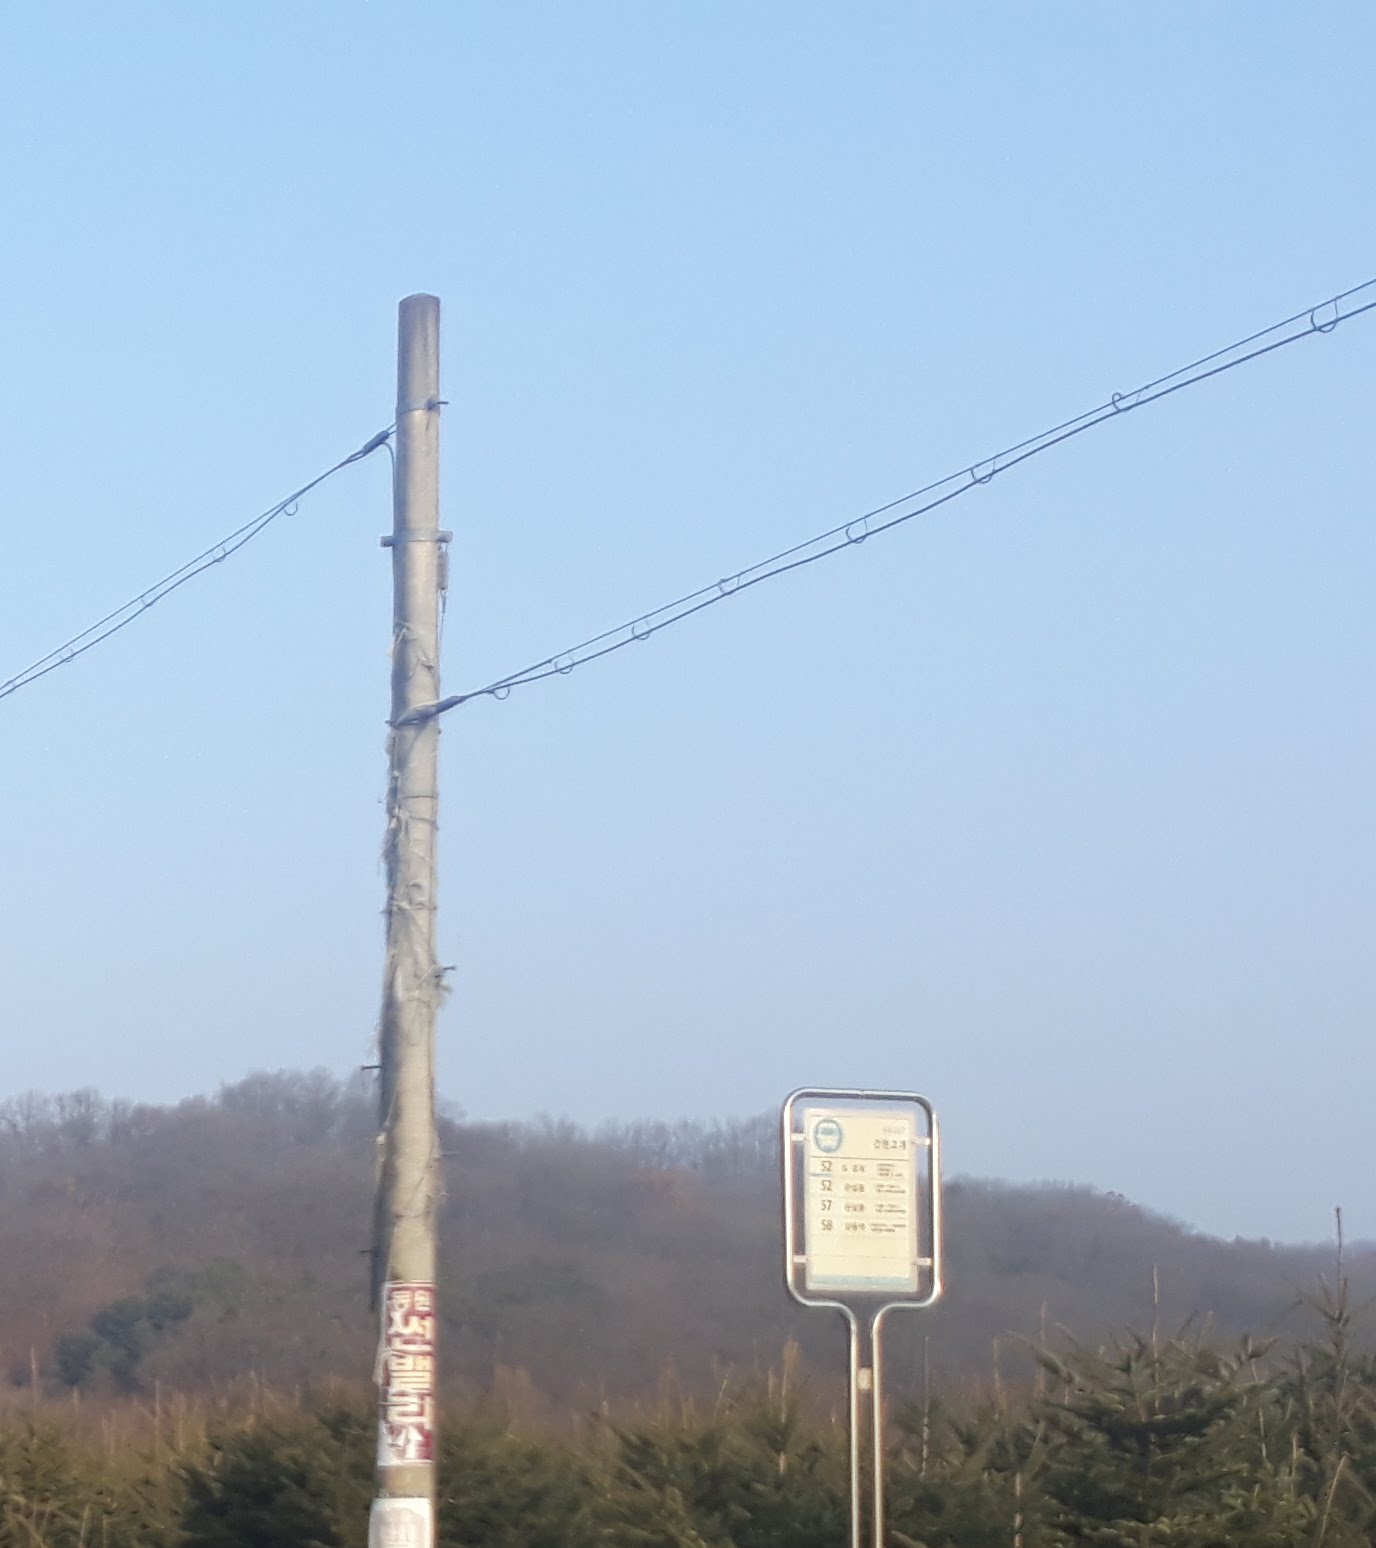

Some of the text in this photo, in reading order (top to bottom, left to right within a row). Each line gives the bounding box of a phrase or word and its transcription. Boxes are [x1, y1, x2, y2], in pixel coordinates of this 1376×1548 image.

[820, 1161, 833, 1172] 52
[820, 1180, 833, 1191] 52
[820, 1200, 833, 1211] 57
